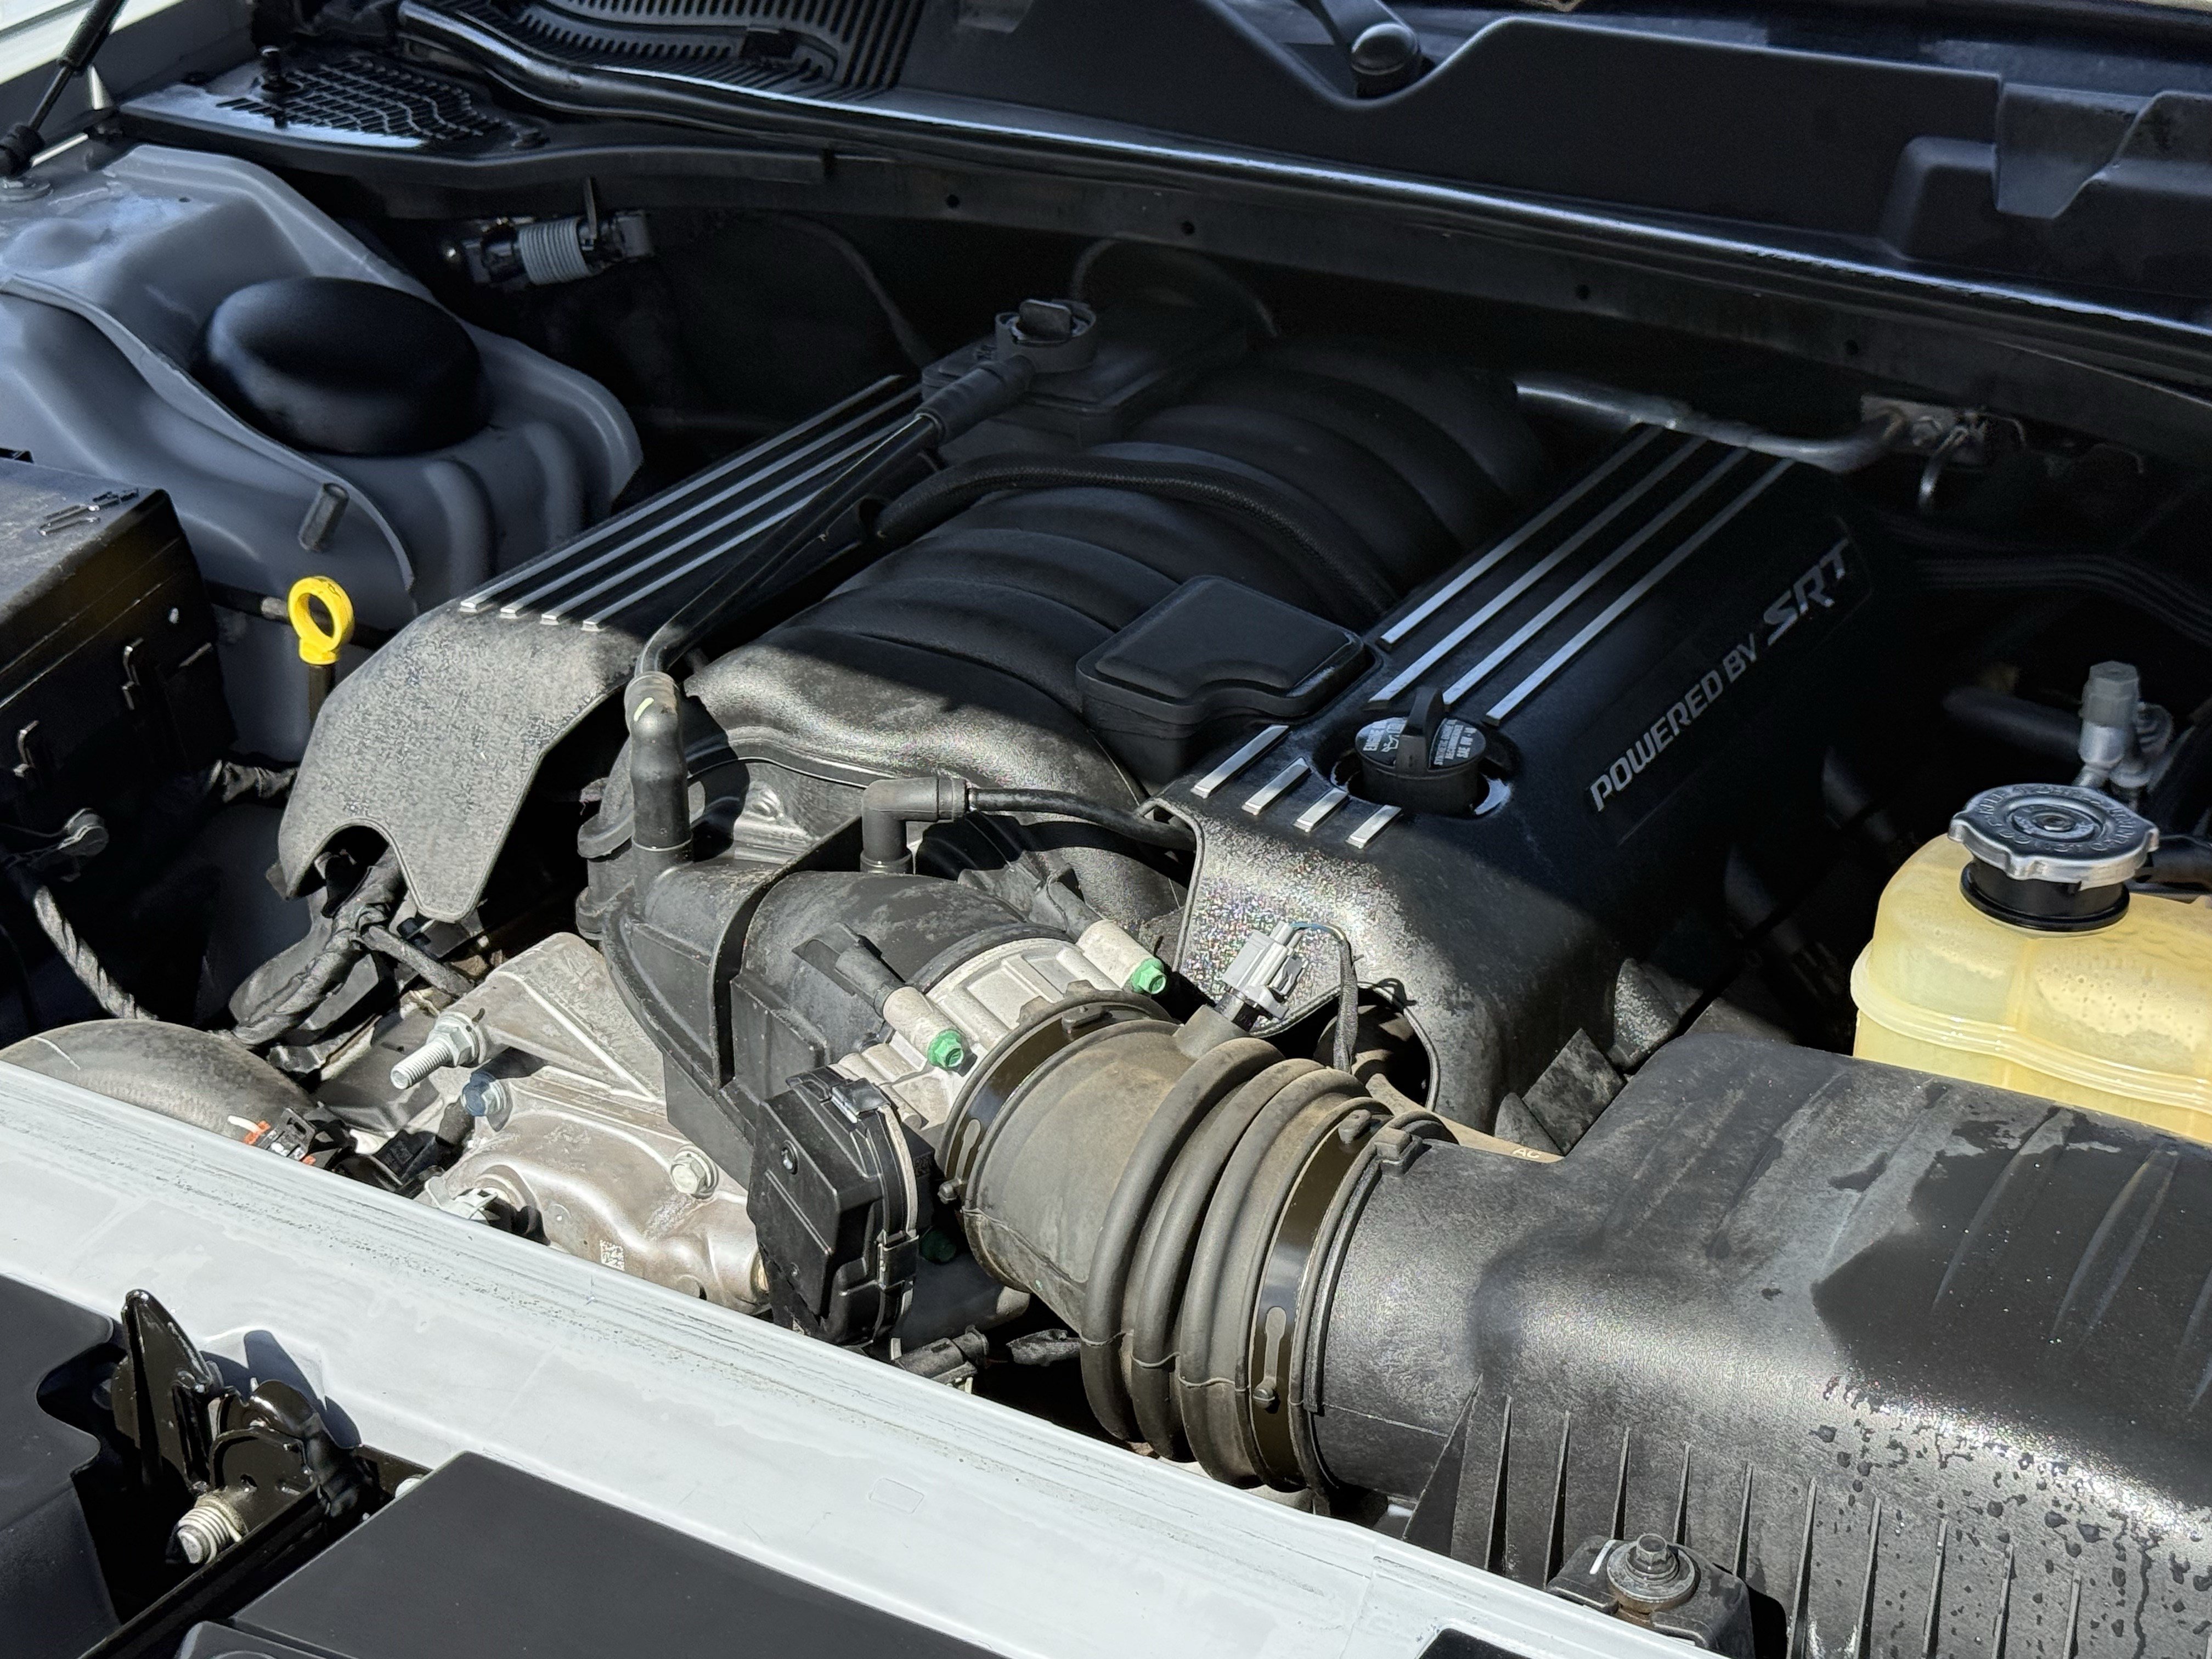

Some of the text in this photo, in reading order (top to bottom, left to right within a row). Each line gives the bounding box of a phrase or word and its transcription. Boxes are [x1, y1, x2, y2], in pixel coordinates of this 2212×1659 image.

[1590, 538, 1849, 811] POWERED BY SRT
[1512, 1148, 1542, 1159] AC
